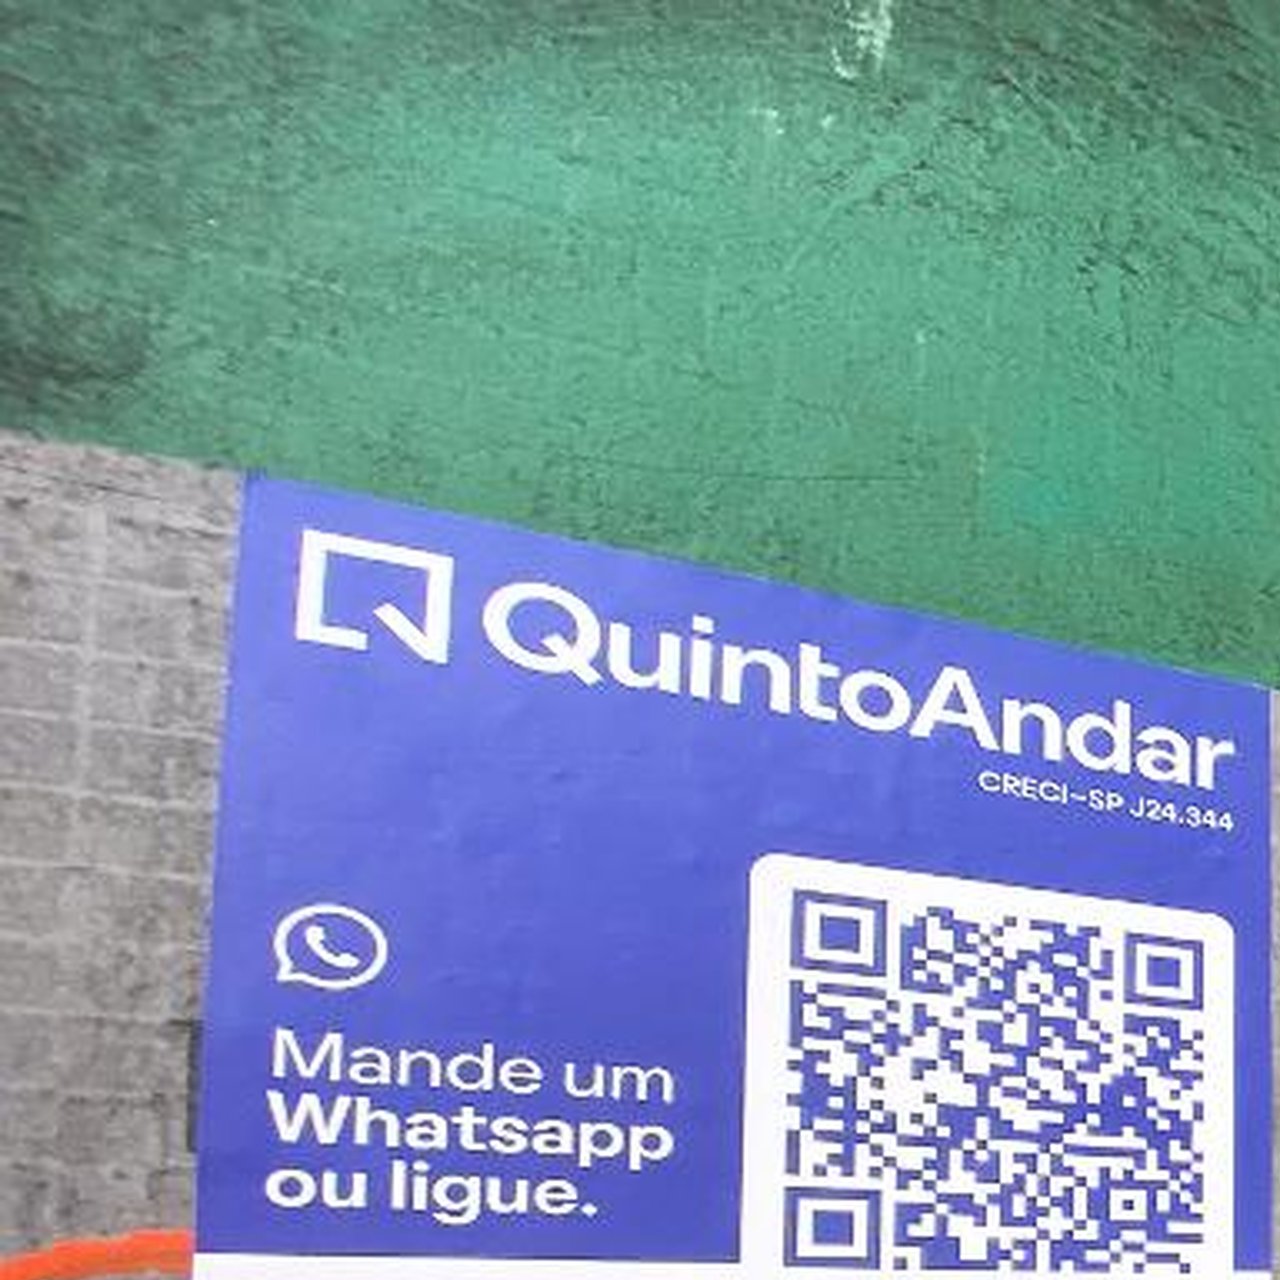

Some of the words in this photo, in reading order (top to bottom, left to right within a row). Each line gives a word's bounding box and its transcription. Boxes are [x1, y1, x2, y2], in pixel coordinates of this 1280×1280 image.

[482, 581, 1235, 791] QuintoAndar
[978, 770, 1124, 811] CRECI-SP
[1129, 797, 1235, 832] J24.344
[272, 1028, 542, 1095] Mande
[563, 1061, 676, 1104] um
[266, 1090, 675, 1171] Whatsapp
[264, 1166, 369, 1208] ou
[390, 1160, 599, 1226] ligue.
